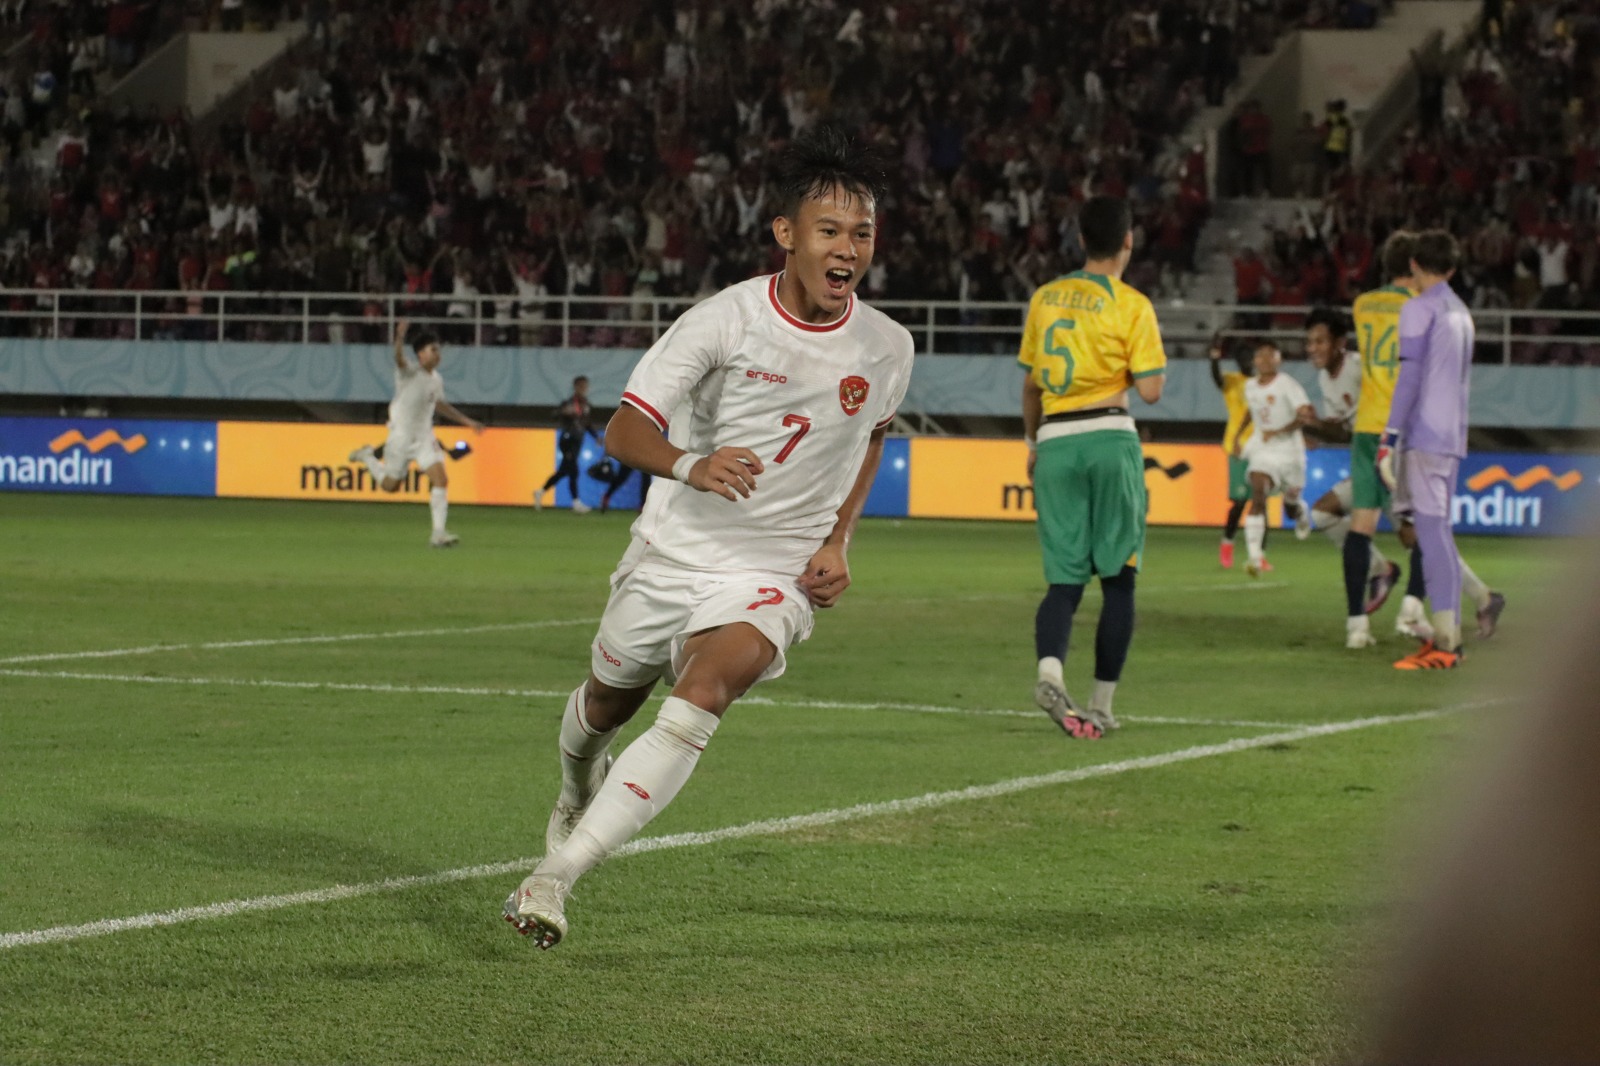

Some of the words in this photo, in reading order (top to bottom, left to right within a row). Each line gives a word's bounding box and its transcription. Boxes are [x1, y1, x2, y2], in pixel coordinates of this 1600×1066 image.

[1042, 318, 1075, 395] 5
[1363, 323, 1396, 379] 14
[746, 369, 787, 384] erspo
[773, 413, 811, 464] 7
[300, 462, 432, 493] manir
[1451, 486, 1542, 527] ndiri
[746, 587, 784, 611] 7
